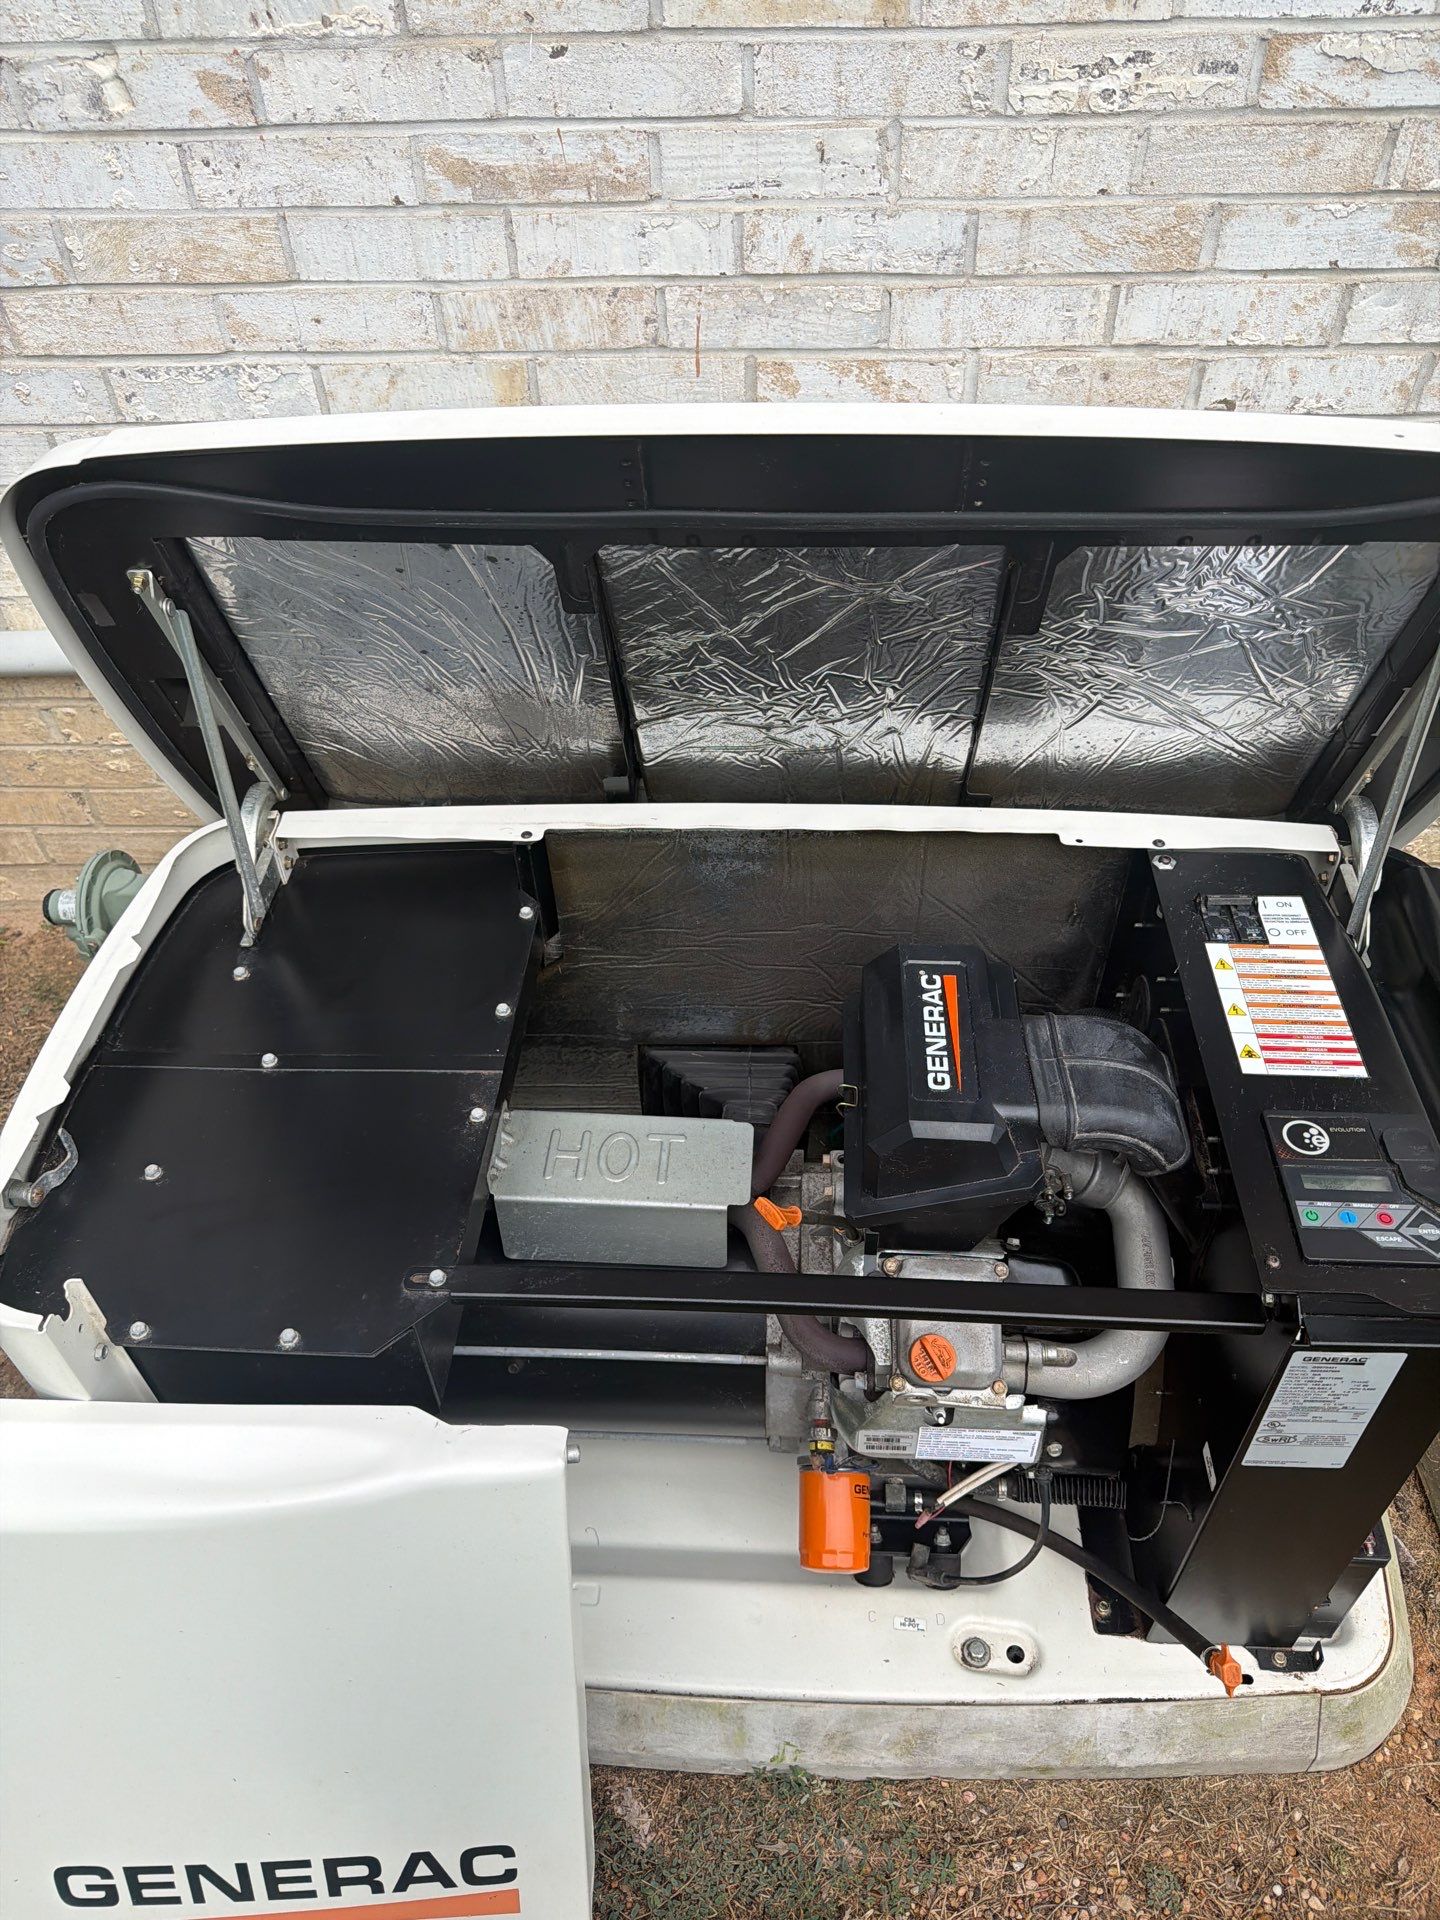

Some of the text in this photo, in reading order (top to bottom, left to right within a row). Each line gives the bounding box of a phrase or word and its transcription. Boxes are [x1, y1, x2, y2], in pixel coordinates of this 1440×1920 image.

[920, 973, 951, 1091] GENERAC
[542, 1128, 688, 1185] HOT
[1375, 1235, 1403, 1243] ESCAPE
[52, 1844, 519, 1908] GENERAC
